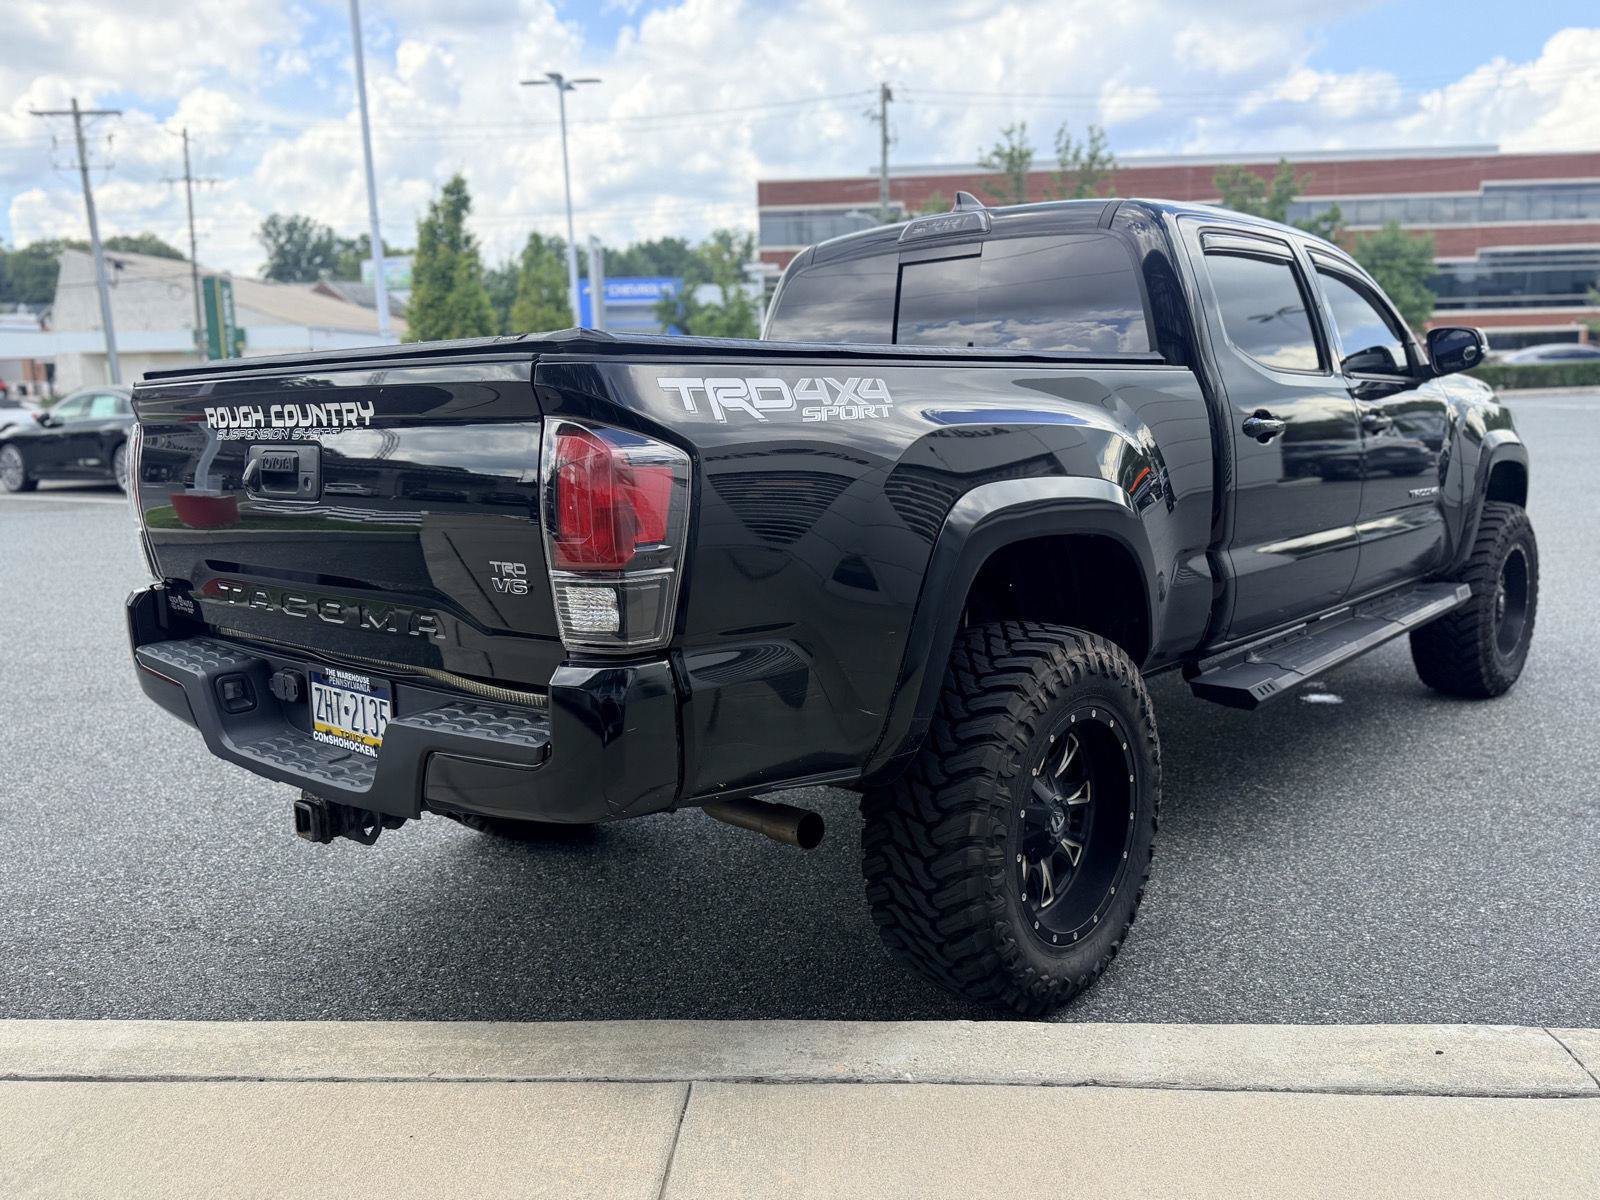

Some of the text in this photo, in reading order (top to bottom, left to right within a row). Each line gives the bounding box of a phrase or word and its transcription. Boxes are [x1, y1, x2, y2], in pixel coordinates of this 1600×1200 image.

[656, 377, 797, 424] TRD
[204, 401, 375, 429] ROUGH COUNTRY
[802, 403, 894, 423] SPORT
[216, 426, 364, 441] SUSPENSION SYSTE
[260, 456, 294, 471] TOYOTA
[489, 560, 527, 578] TRD
[491, 577, 528, 595] V6
[216, 582, 447, 640] TACOMA
[325, 667, 370, 685] THE WAREHOUSE
[328, 675, 371, 693] PENNSYLVANIA
[340, 730, 366, 743] TRUCK
